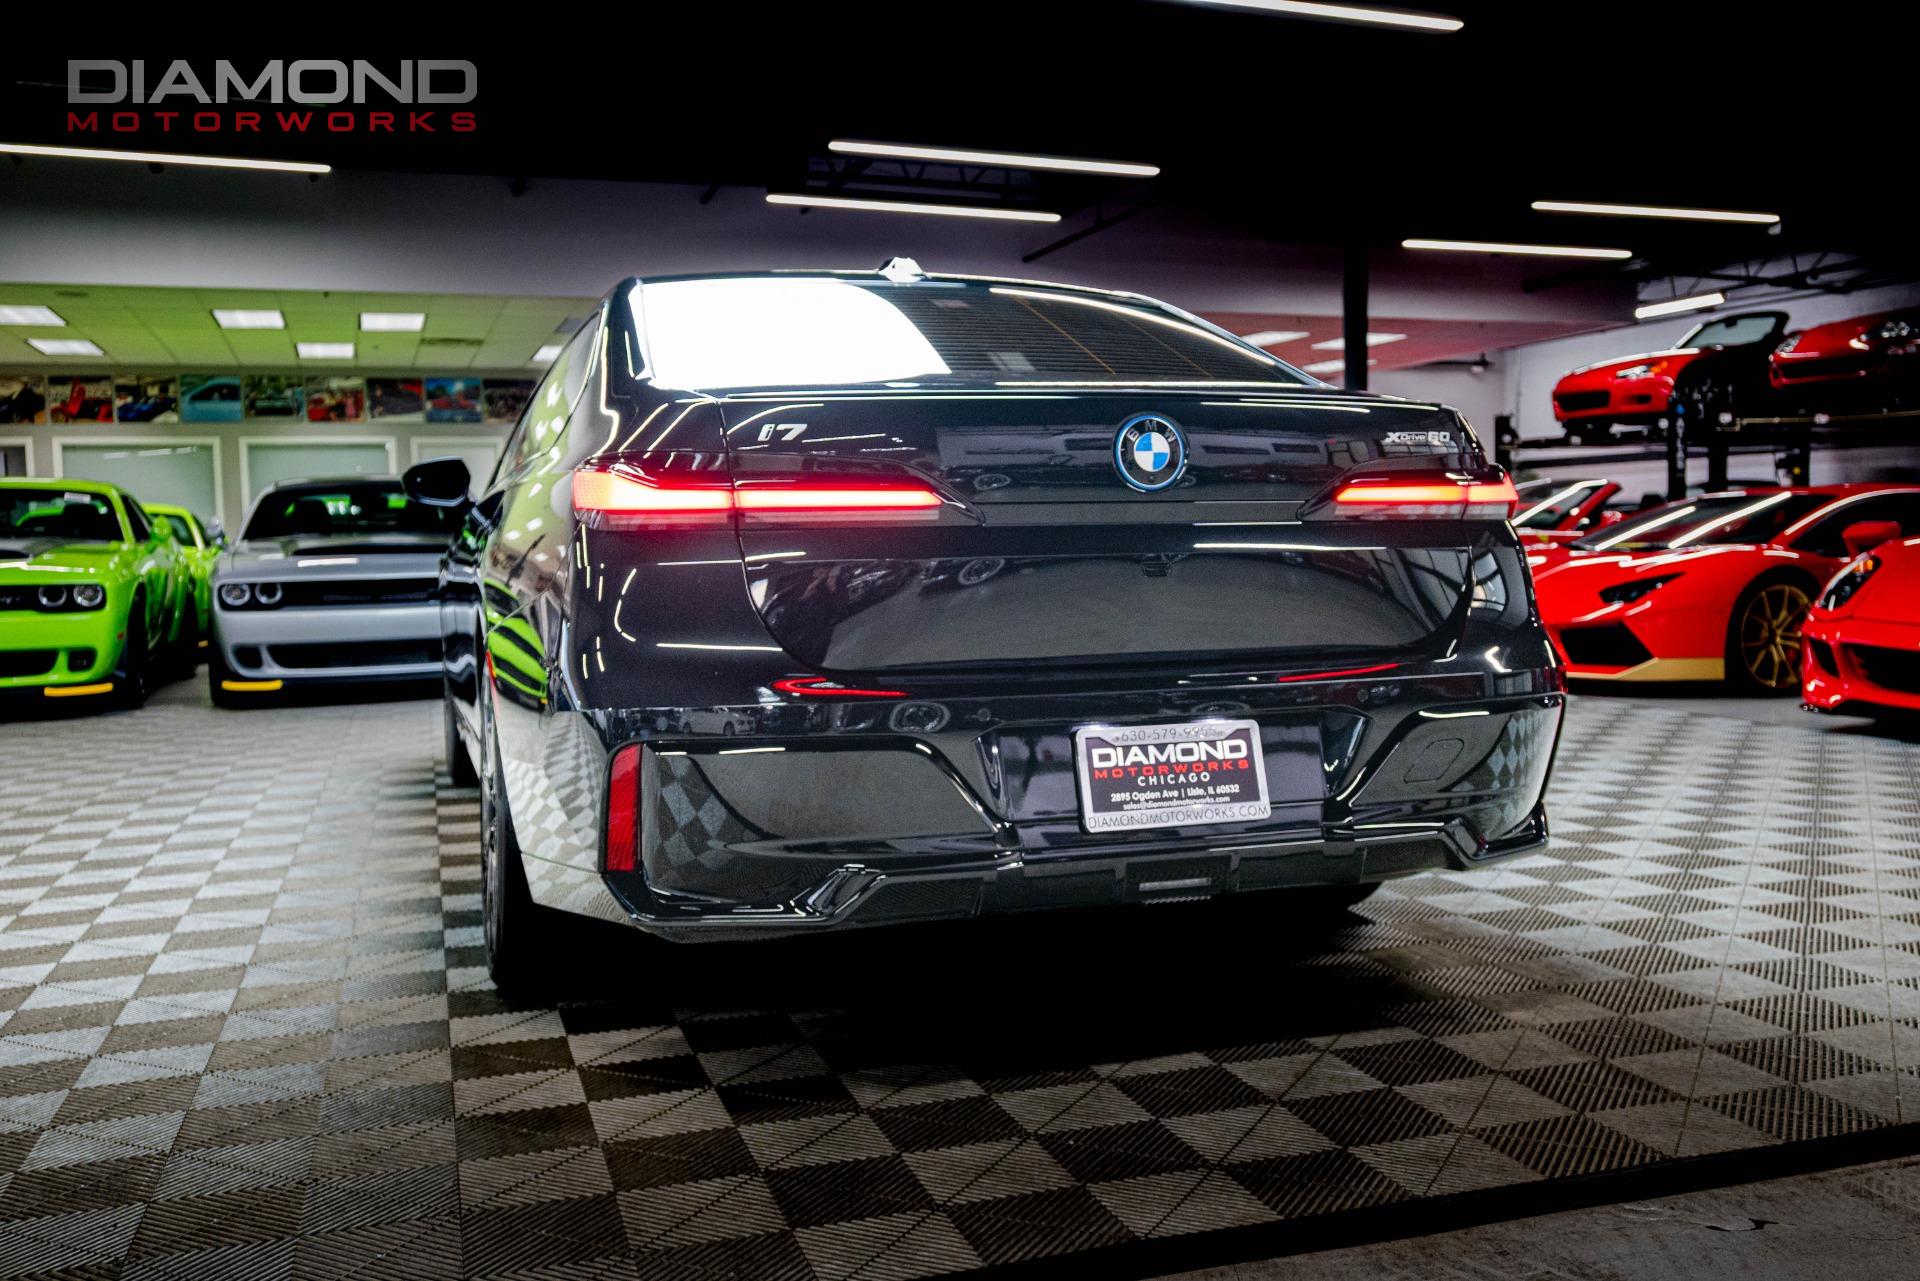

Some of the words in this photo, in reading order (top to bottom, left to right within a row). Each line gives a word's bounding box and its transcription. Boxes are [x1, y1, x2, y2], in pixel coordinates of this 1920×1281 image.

[758, 424, 808, 441] i7
[1126, 420, 1176, 442] BMW
[1092, 739, 1248, 768] DIAMOND
[1094, 759, 1249, 780] MOTORWORKS
[1137, 772, 1211, 787] CHICAGO
[1111, 792, 1131, 802] 2895
[1132, 791, 1161, 802] Ogden
[1162, 789, 1179, 799] Ave
[1207, 786, 1216, 795] IL
[1216, 784, 1240, 795] 60532
[1088, 805, 1269, 829] DIAMONDMOTORWORKS.COM
